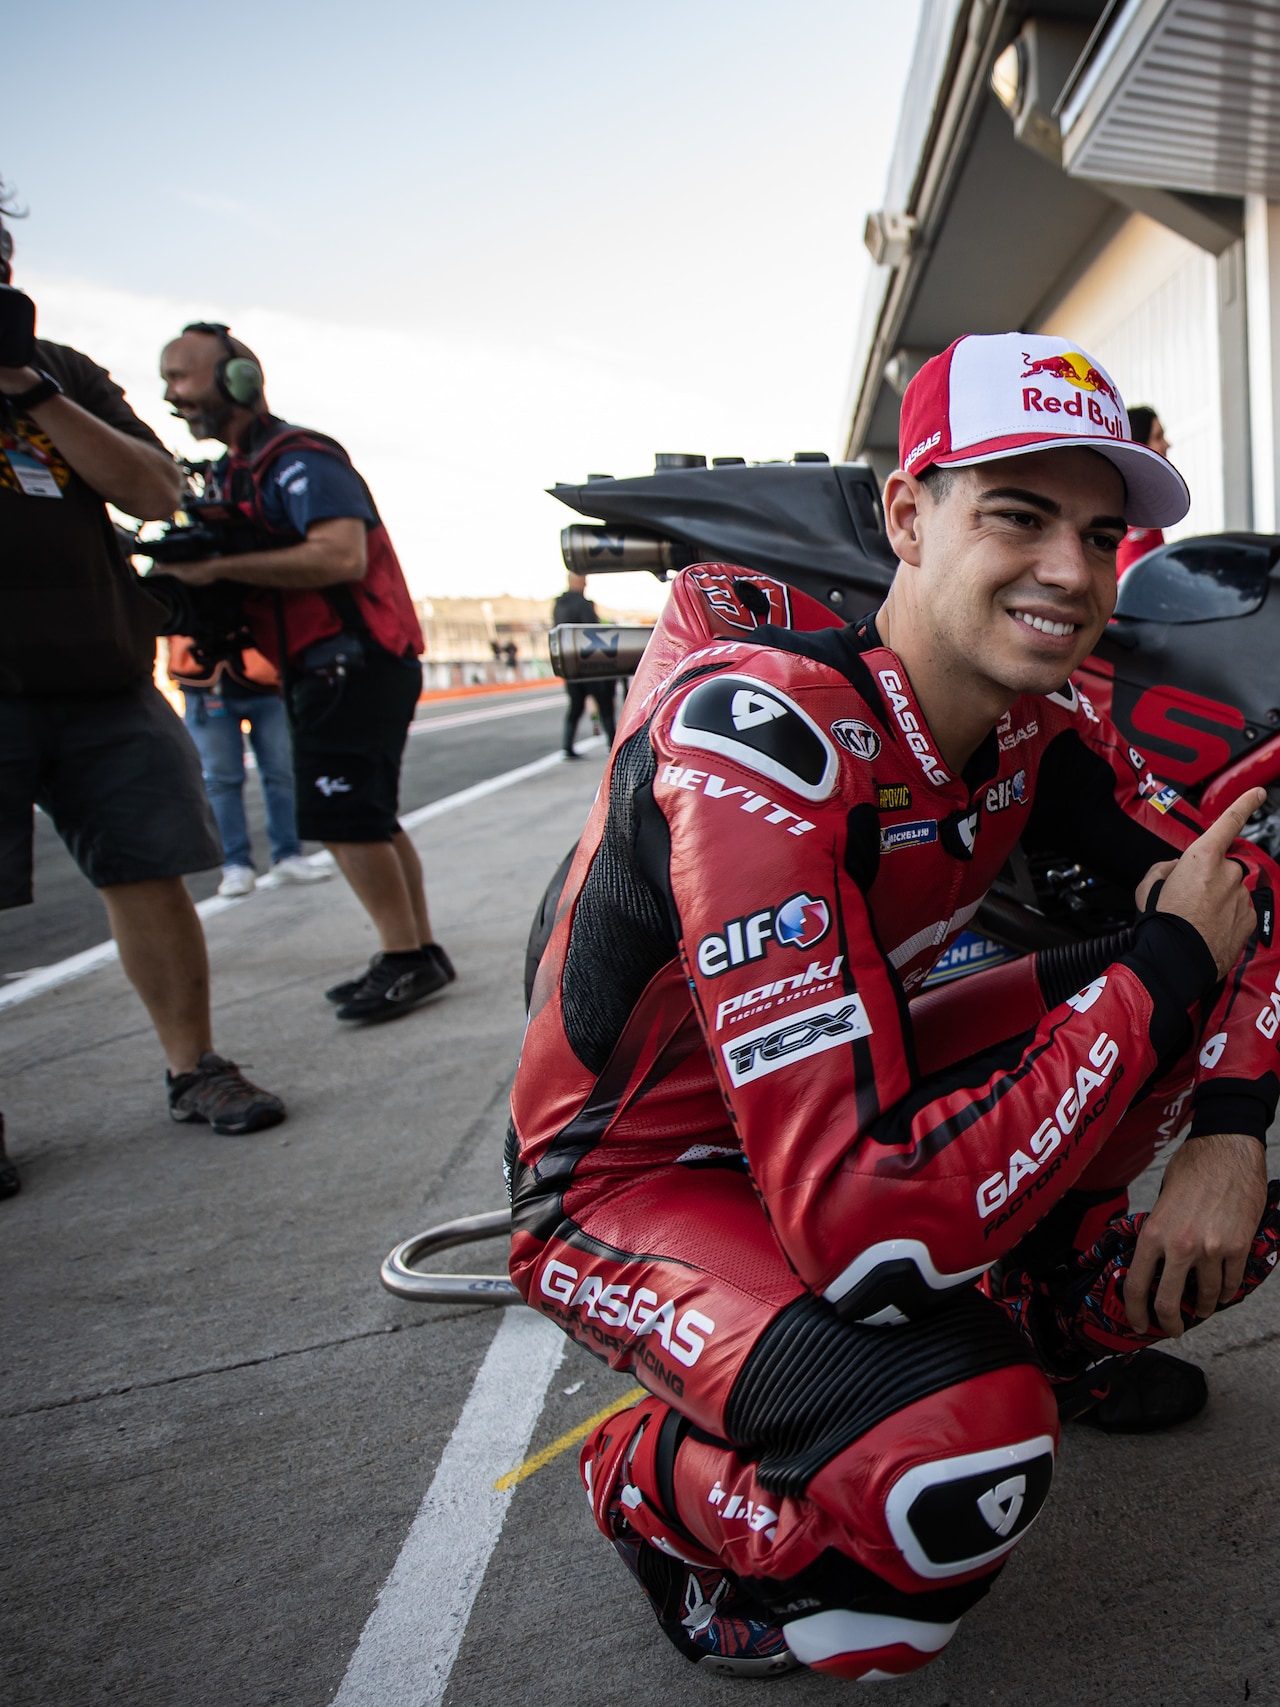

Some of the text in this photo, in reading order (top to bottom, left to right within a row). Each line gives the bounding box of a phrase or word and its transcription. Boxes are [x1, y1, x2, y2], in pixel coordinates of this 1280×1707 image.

[1022, 387, 1124, 440] Red Bull
[878, 669, 951, 786] GASGAS
[660, 765, 816, 836] REV'IT!
[986, 779, 1013, 812] elf
[697, 911, 772, 976] elf
[715, 955, 845, 1032] pankl
[729, 981, 835, 1025] RACING SYSTEMS
[729, 1003, 857, 1075] TCX
[976, 1032, 1120, 1218] GASGAS
[983, 1062, 1125, 1241] FACTORY RACING
[539, 1258, 716, 1368] GASGAS
